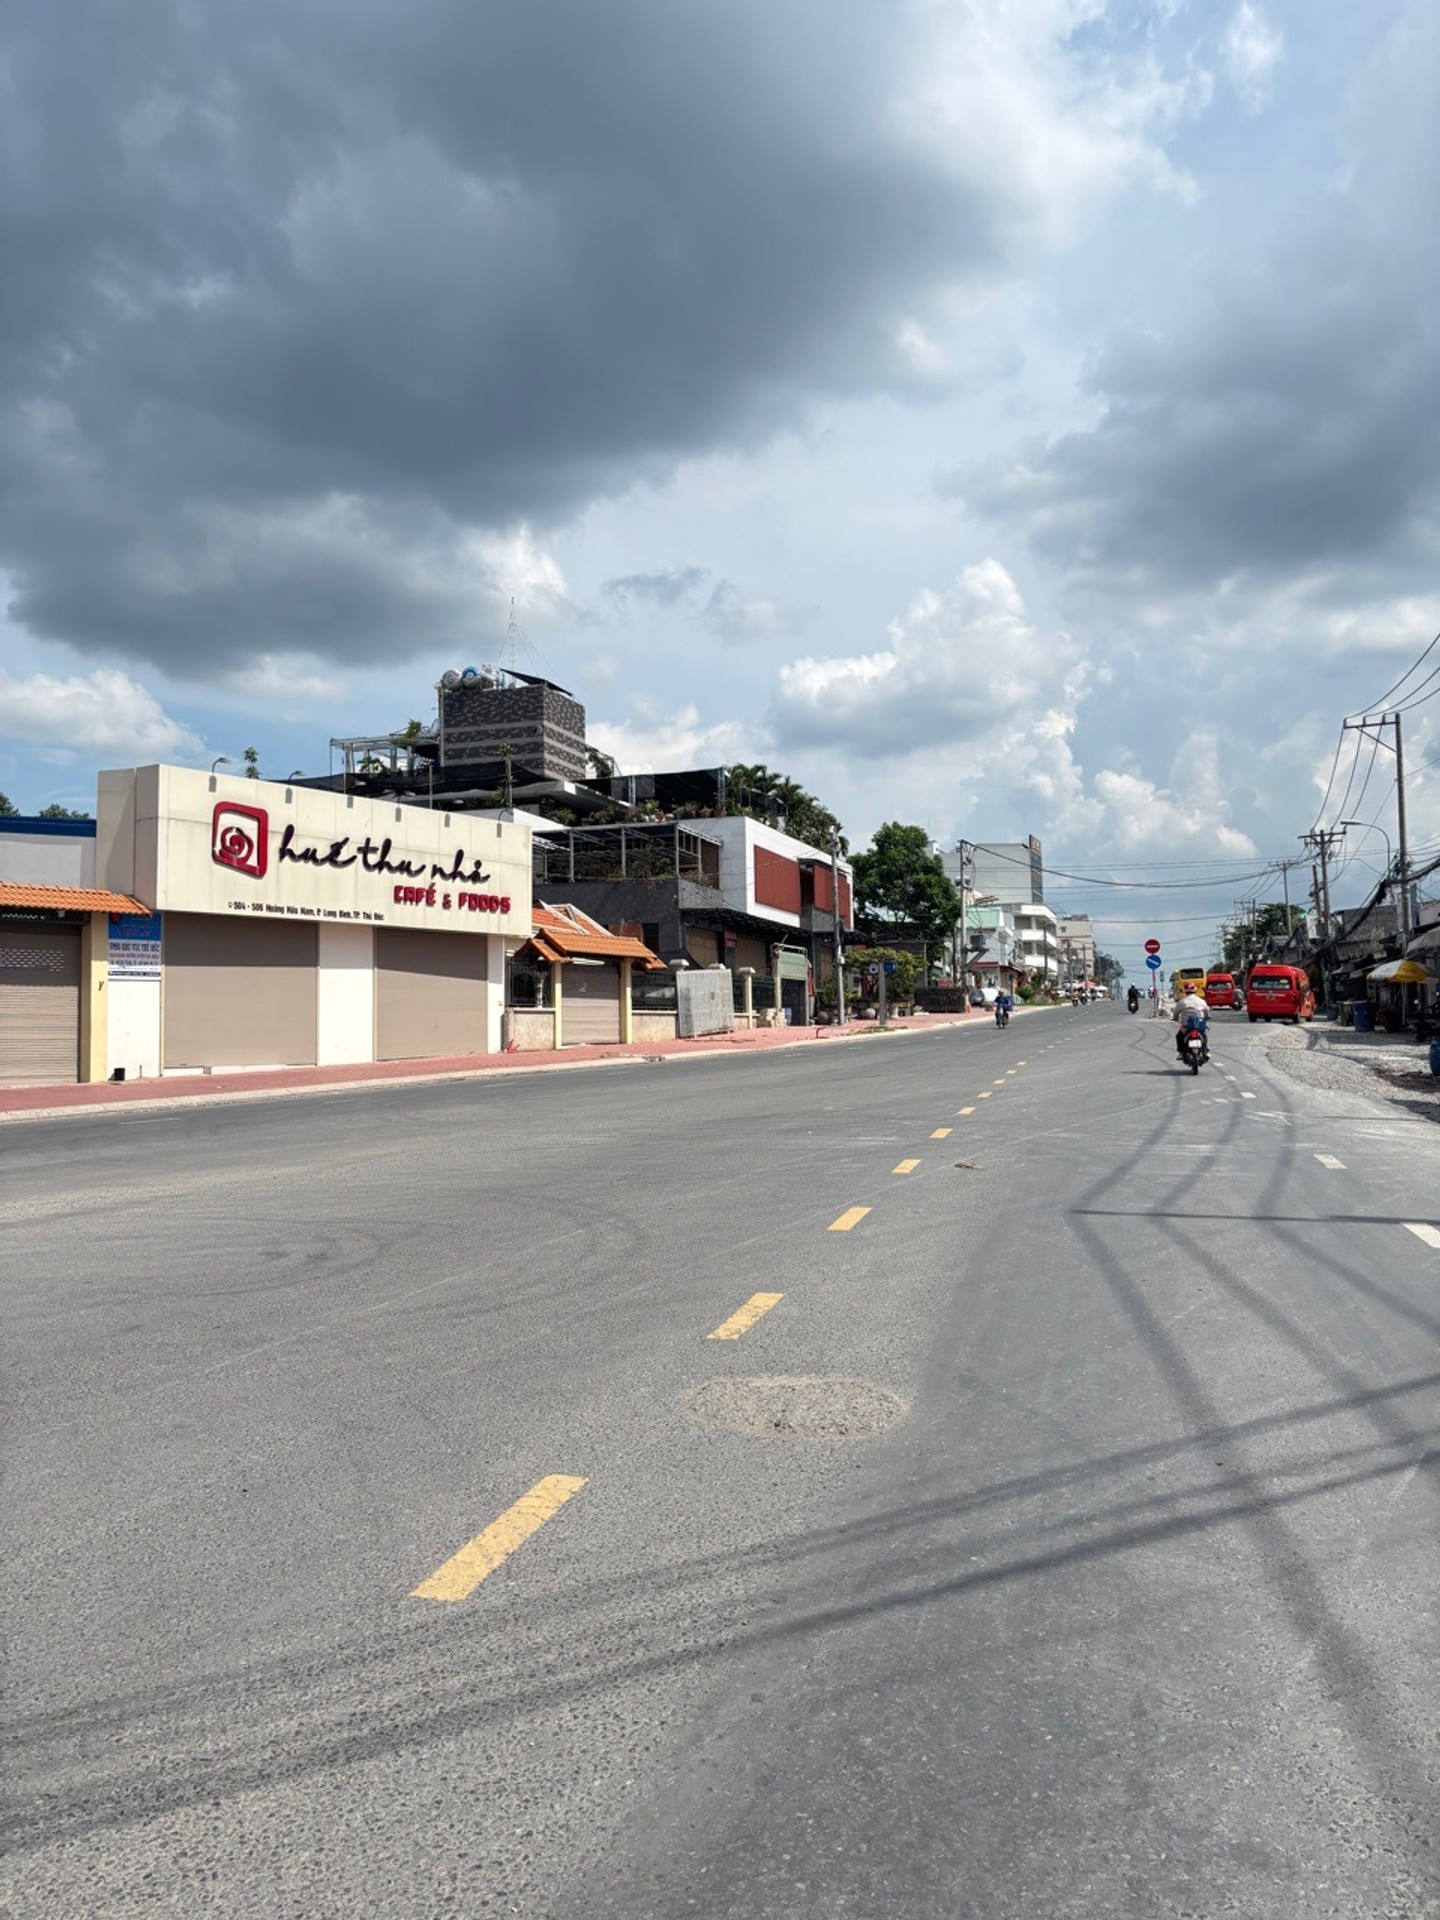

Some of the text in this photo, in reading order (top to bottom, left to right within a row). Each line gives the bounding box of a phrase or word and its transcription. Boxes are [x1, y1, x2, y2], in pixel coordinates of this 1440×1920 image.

[279, 824, 357, 869] huế
[357, 837, 426, 876] thu
[233, 901, 246, 910] 504
[252, 903, 264, 912] 506
[266, 904, 285, 914] Hoàng
[323, 909, 337, 918] Long
[393, 882, 511, 914] CAFÉ & FOODS
